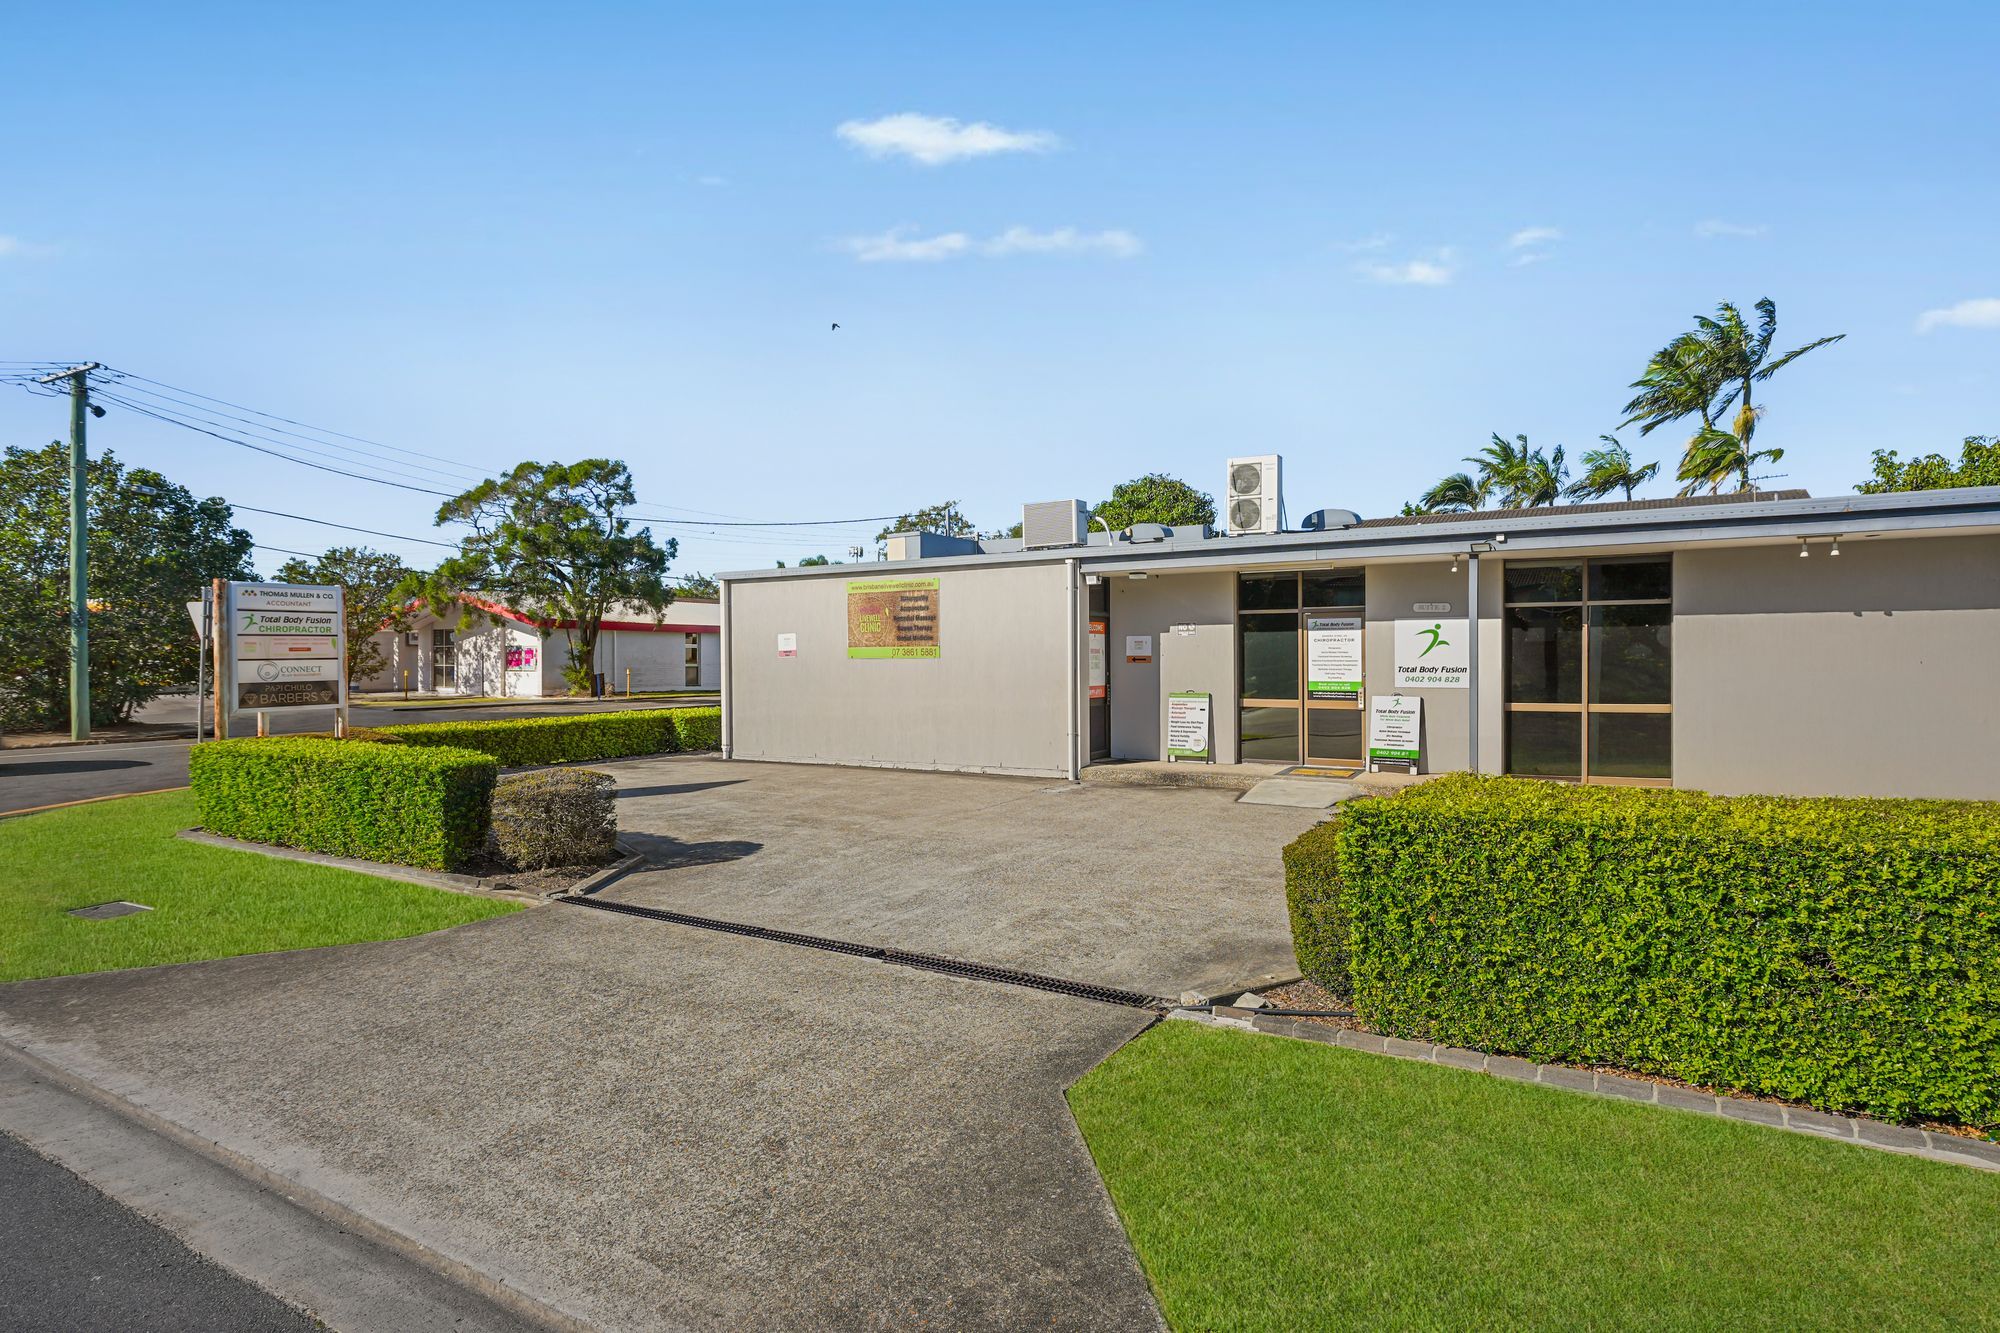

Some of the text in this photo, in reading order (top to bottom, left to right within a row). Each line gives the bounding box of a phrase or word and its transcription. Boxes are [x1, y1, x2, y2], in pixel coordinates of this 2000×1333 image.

[851, 581, 934, 590] www.brisbanelivewellclinic.com.au
[259, 590, 288, 598] THOMAS
[290, 591, 314, 599] MULLEN
[260, 615, 332, 625] Total Body Fusion
[859, 614, 881, 622] LIVEWELL
[258, 625, 332, 633] CHIROPRACTOR
[860, 621, 881, 633] CLINIC
[891, 647, 900, 656] 07
[280, 665, 322, 673] CONNECT
[1419, 666, 1440, 674] Body
[260, 692, 319, 704] BARBERS
